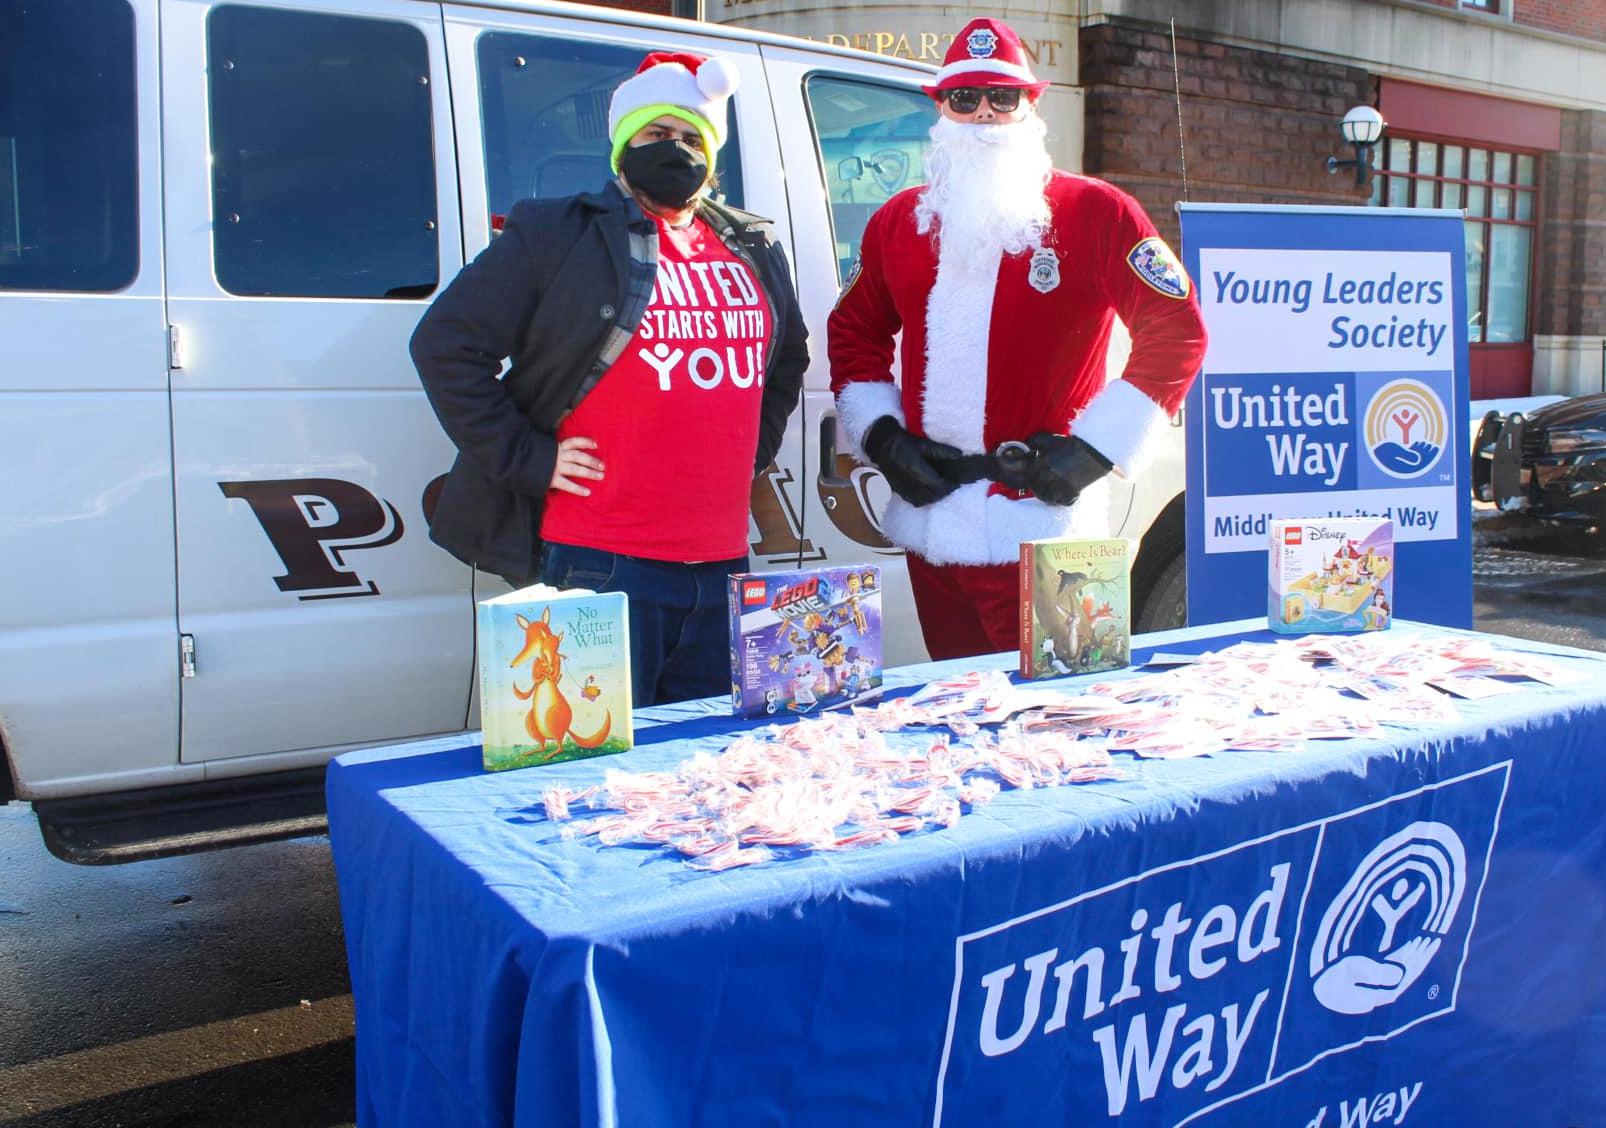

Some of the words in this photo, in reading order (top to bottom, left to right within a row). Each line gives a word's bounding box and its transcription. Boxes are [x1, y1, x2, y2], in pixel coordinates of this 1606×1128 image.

[825, 31, 1063, 67] DEPARNT
[1213, 271, 1313, 313] Young
[1323, 272, 1444, 305] Leaders
[639, 310, 718, 340] STARTS
[721, 310, 765, 339] WITH
[1327, 315, 1447, 356] Society
[638, 342, 764, 391] YOU!
[1211, 384, 1349, 429] United
[1266, 433, 1349, 487] Way
[1397, 506, 1439, 531] Way
[1053, 546, 1087, 561] Where
[1089, 545, 1098, 558] Is
[1099, 544, 1126, 557] Bear?
[746, 586, 765, 599] LEGO
[771, 577, 819, 611] LEGO
[775, 595, 824, 619] MOVIE
[568, 619, 614, 636] Matter
[577, 606, 598, 621] No
[574, 632, 613, 649] What
[978, 861, 1292, 1058] United
[1093, 988, 1270, 1117] Way
[1340, 1081, 1424, 1128] Way
